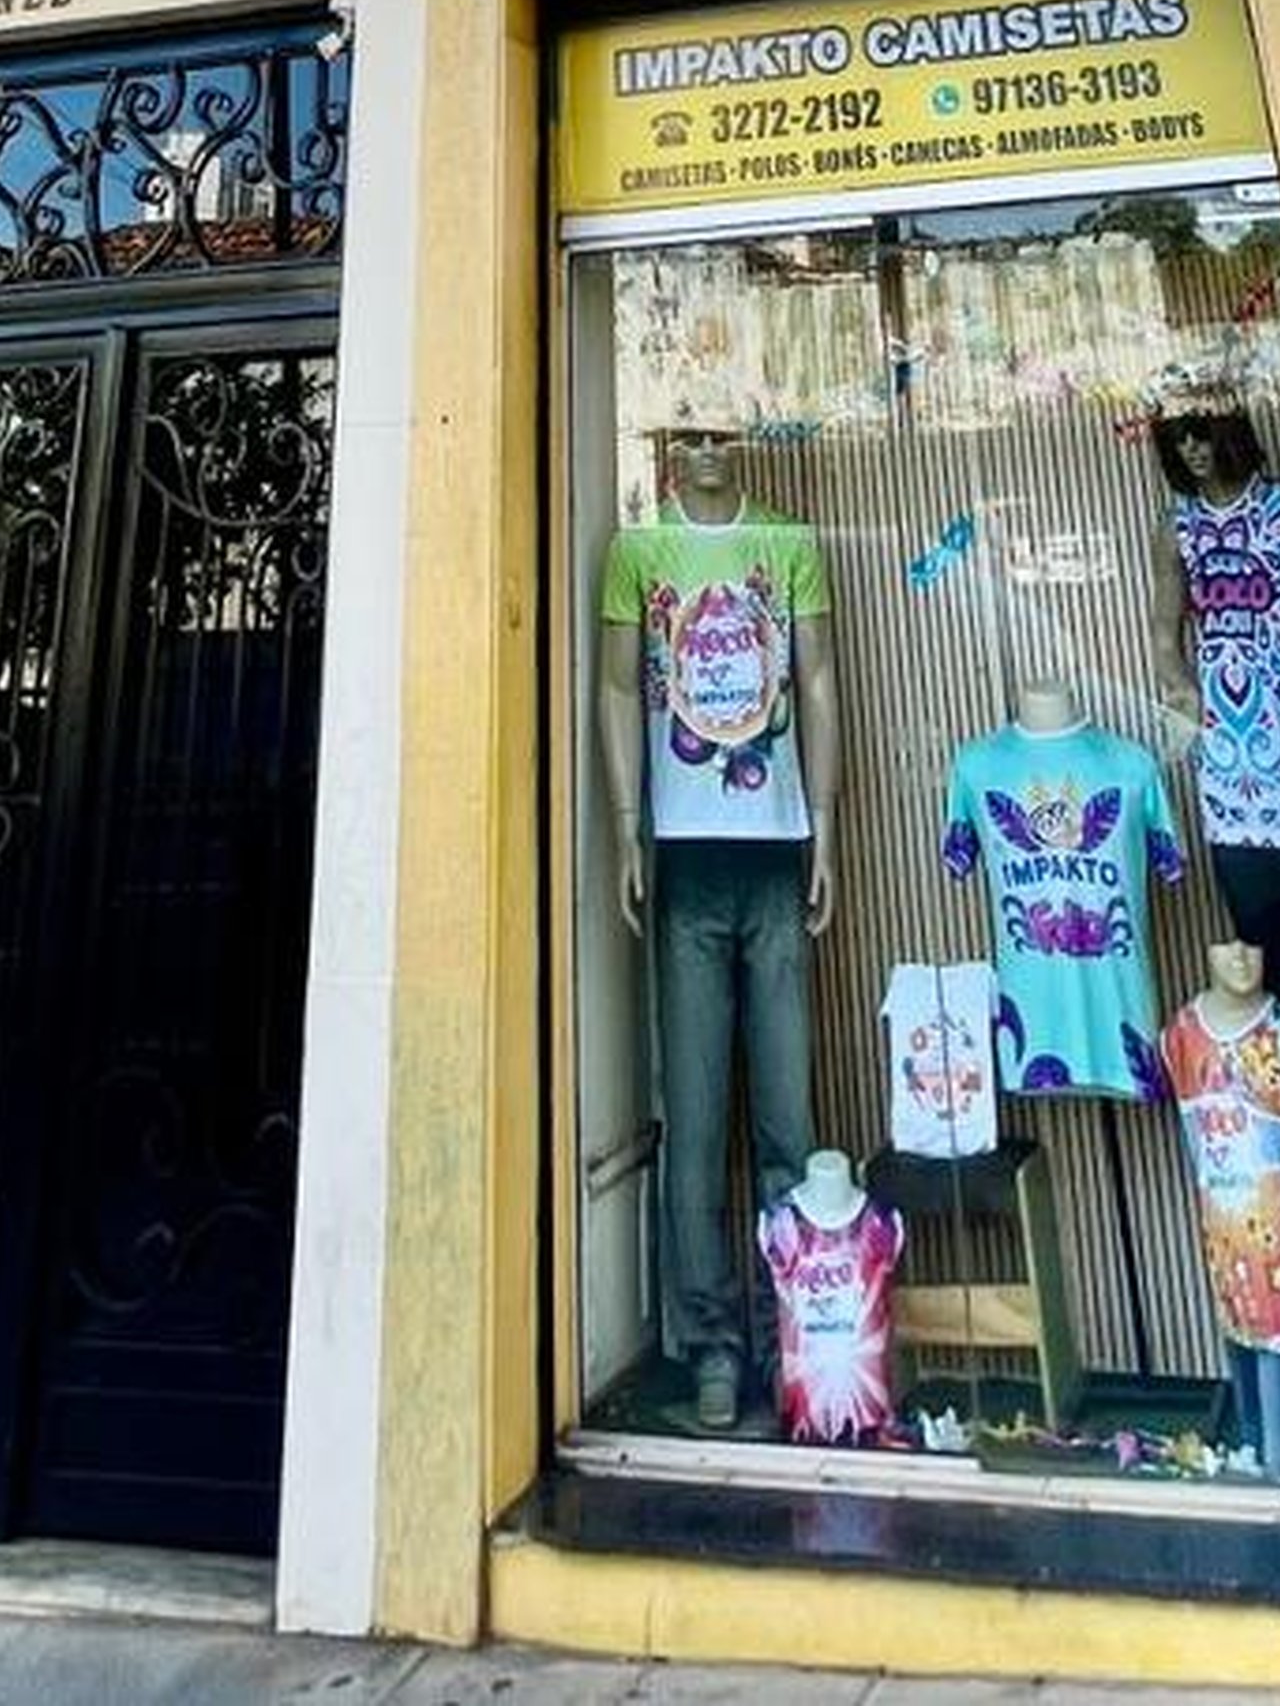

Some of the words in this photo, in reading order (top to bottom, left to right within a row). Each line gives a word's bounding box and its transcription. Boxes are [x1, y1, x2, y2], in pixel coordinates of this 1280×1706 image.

[615, 24, 852, 97] IMPAKTO
[709, 88, 883, 143] 3272-2192
[972, 59, 1162, 115] 97136-3193
[620, 159, 727, 192] CAMISETAS
[738, 152, 800, 181] POLOS
[813, 142, 877, 174] BONÉS
[889, 134, 983, 167] CANECAS
[997, 121, 1118, 155] ALMOFADAS
[1132, 111, 1204, 144] BODYS
[1002, 854, 1120, 888] IMPAKTO
